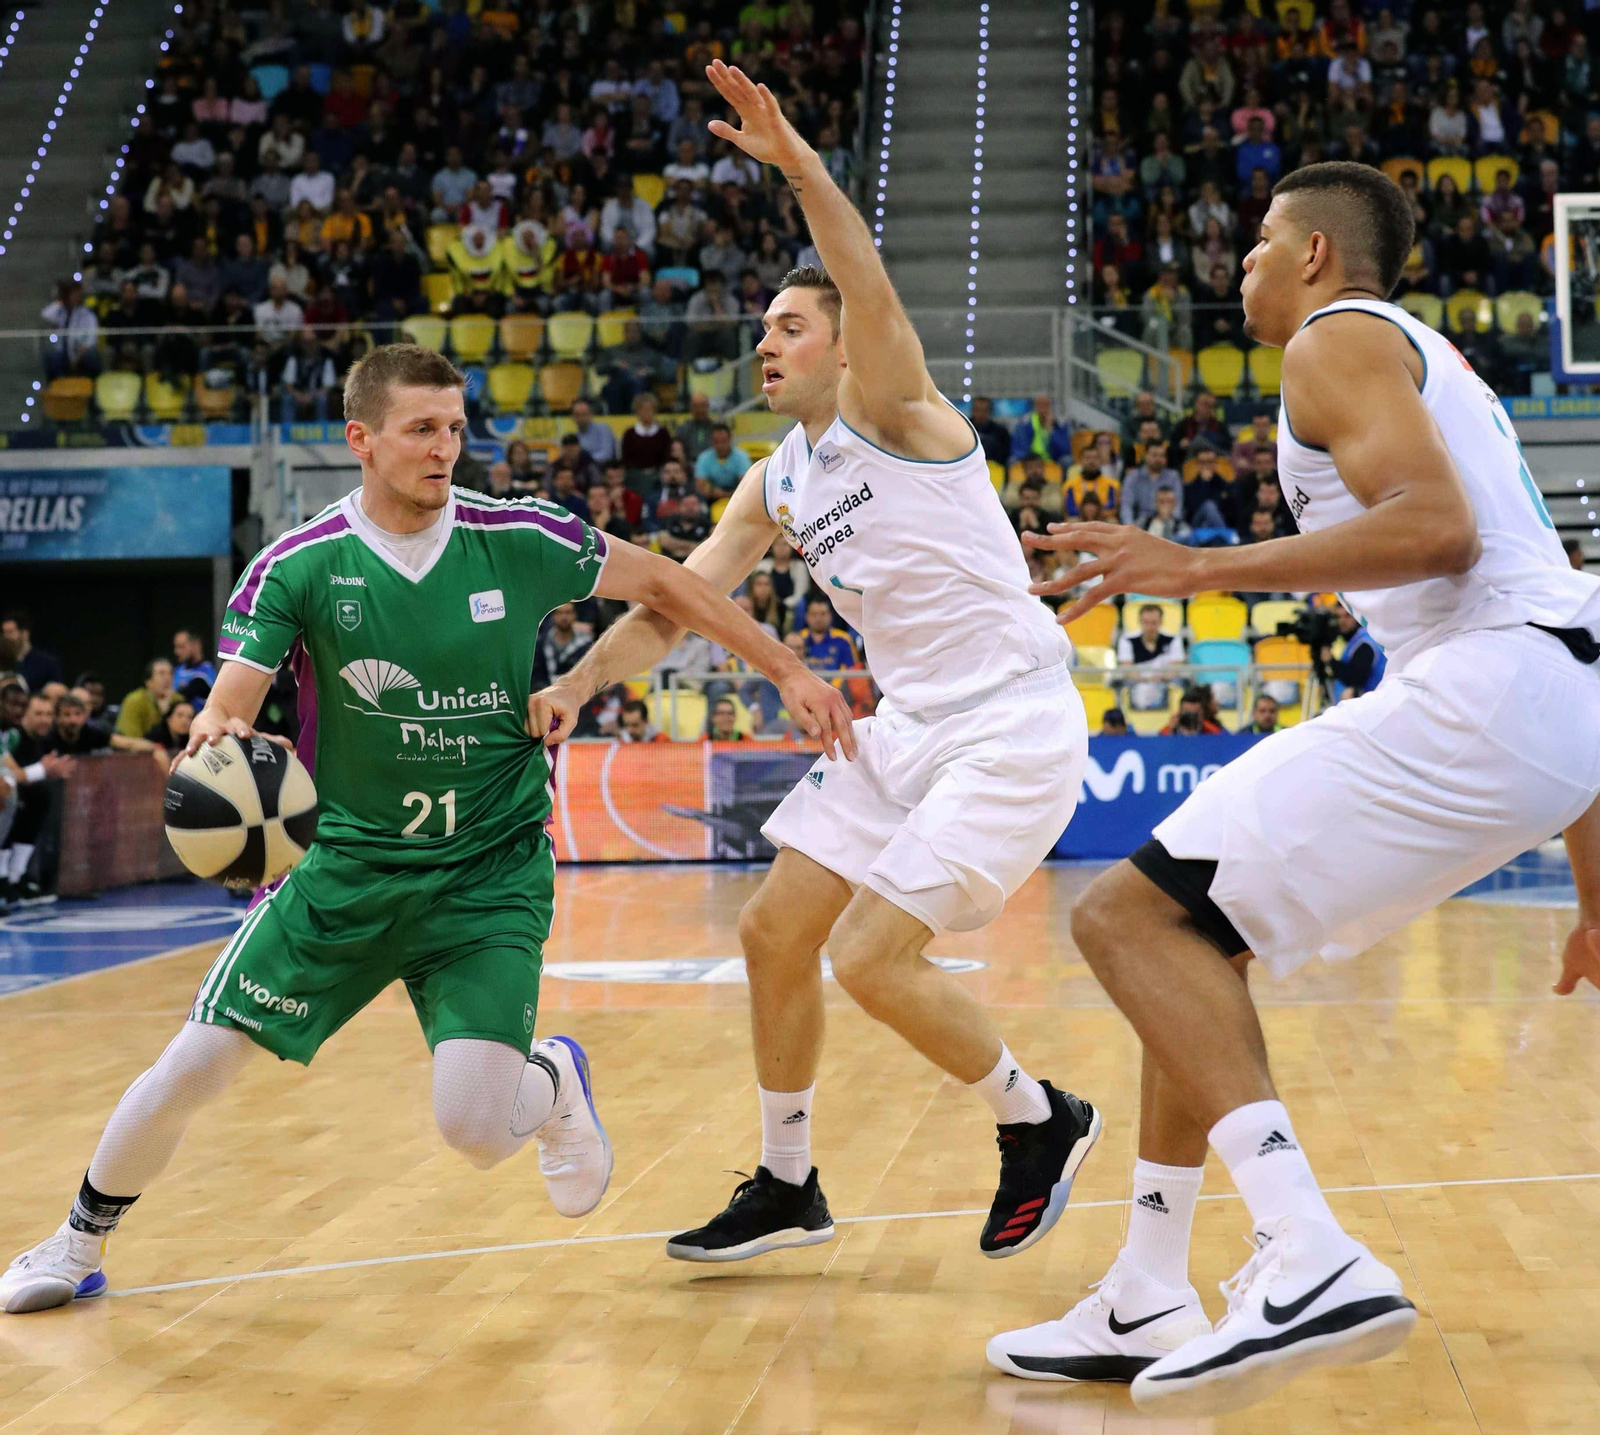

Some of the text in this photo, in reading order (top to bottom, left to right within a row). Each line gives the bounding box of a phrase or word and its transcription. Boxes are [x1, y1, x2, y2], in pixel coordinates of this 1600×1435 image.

[804, 524, 854, 568] Europea
[417, 682, 510, 711] Unicaja
[396, 753, 460, 762] Ciudad Genial
[400, 722, 481, 765] Málaga
[401, 789, 456, 838] 21
[1257, 1143, 1298, 1157] adidas
[1137, 1198, 1169, 1214] adidas
